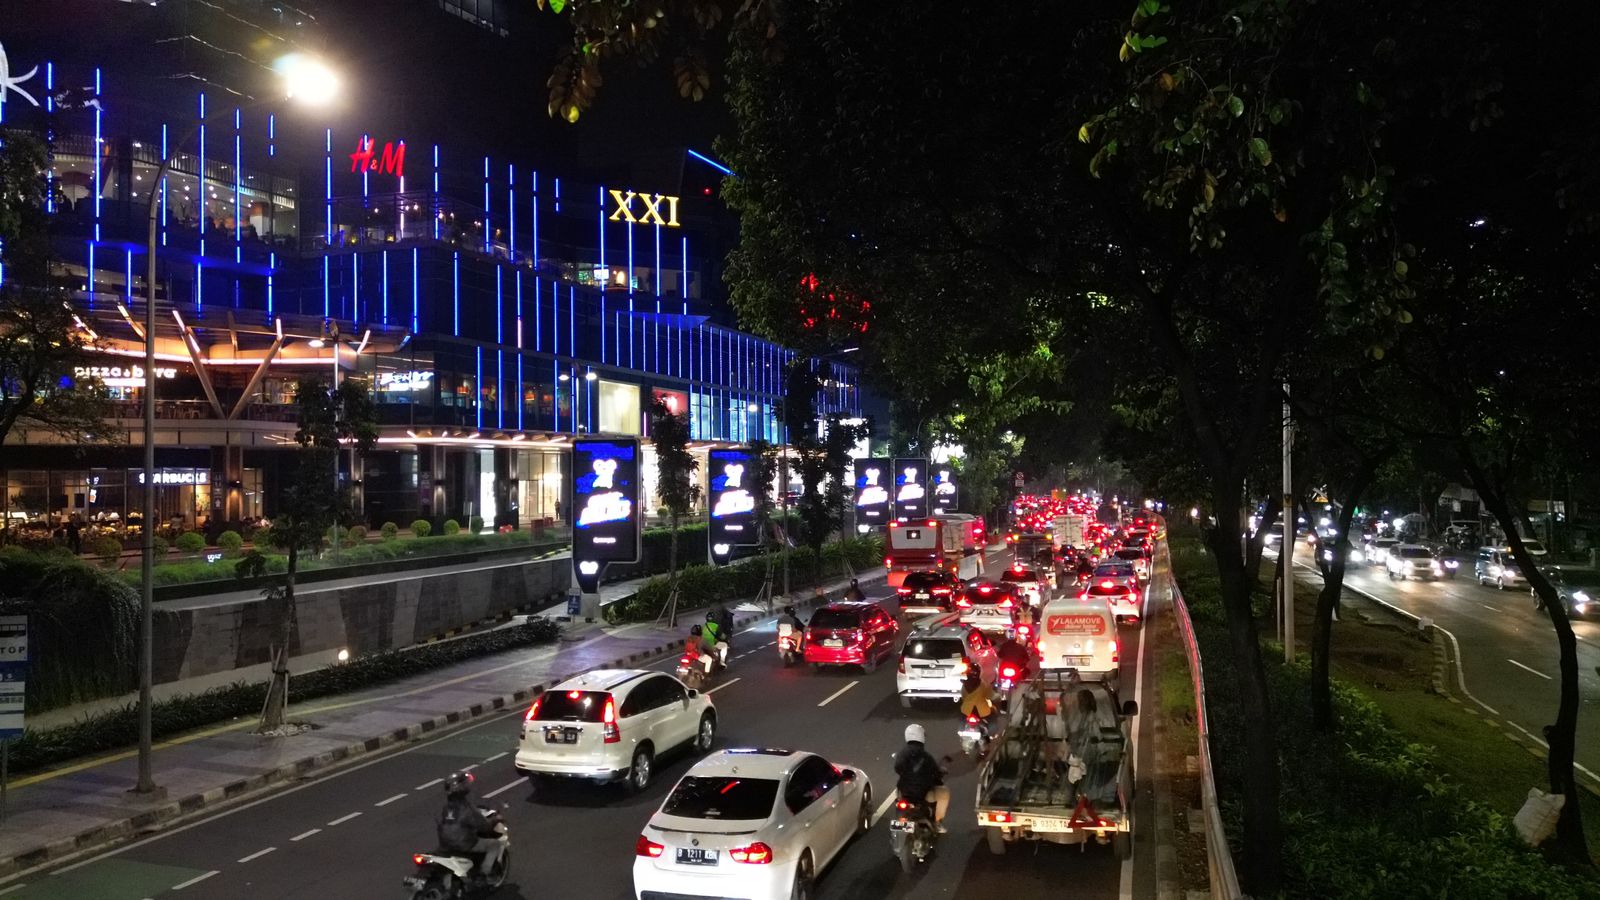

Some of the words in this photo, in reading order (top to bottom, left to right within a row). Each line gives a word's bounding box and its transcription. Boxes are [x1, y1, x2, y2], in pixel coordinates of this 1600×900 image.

[349, 138, 406, 176] H&M
[609, 189, 680, 227] XXI
[132, 364, 177, 379] bra
[138, 472, 207, 484] SARBUCKS
[1060, 617, 1101, 625] LALAMOVE
[677, 848, 683, 858] B
[687, 849, 702, 858] 1211
